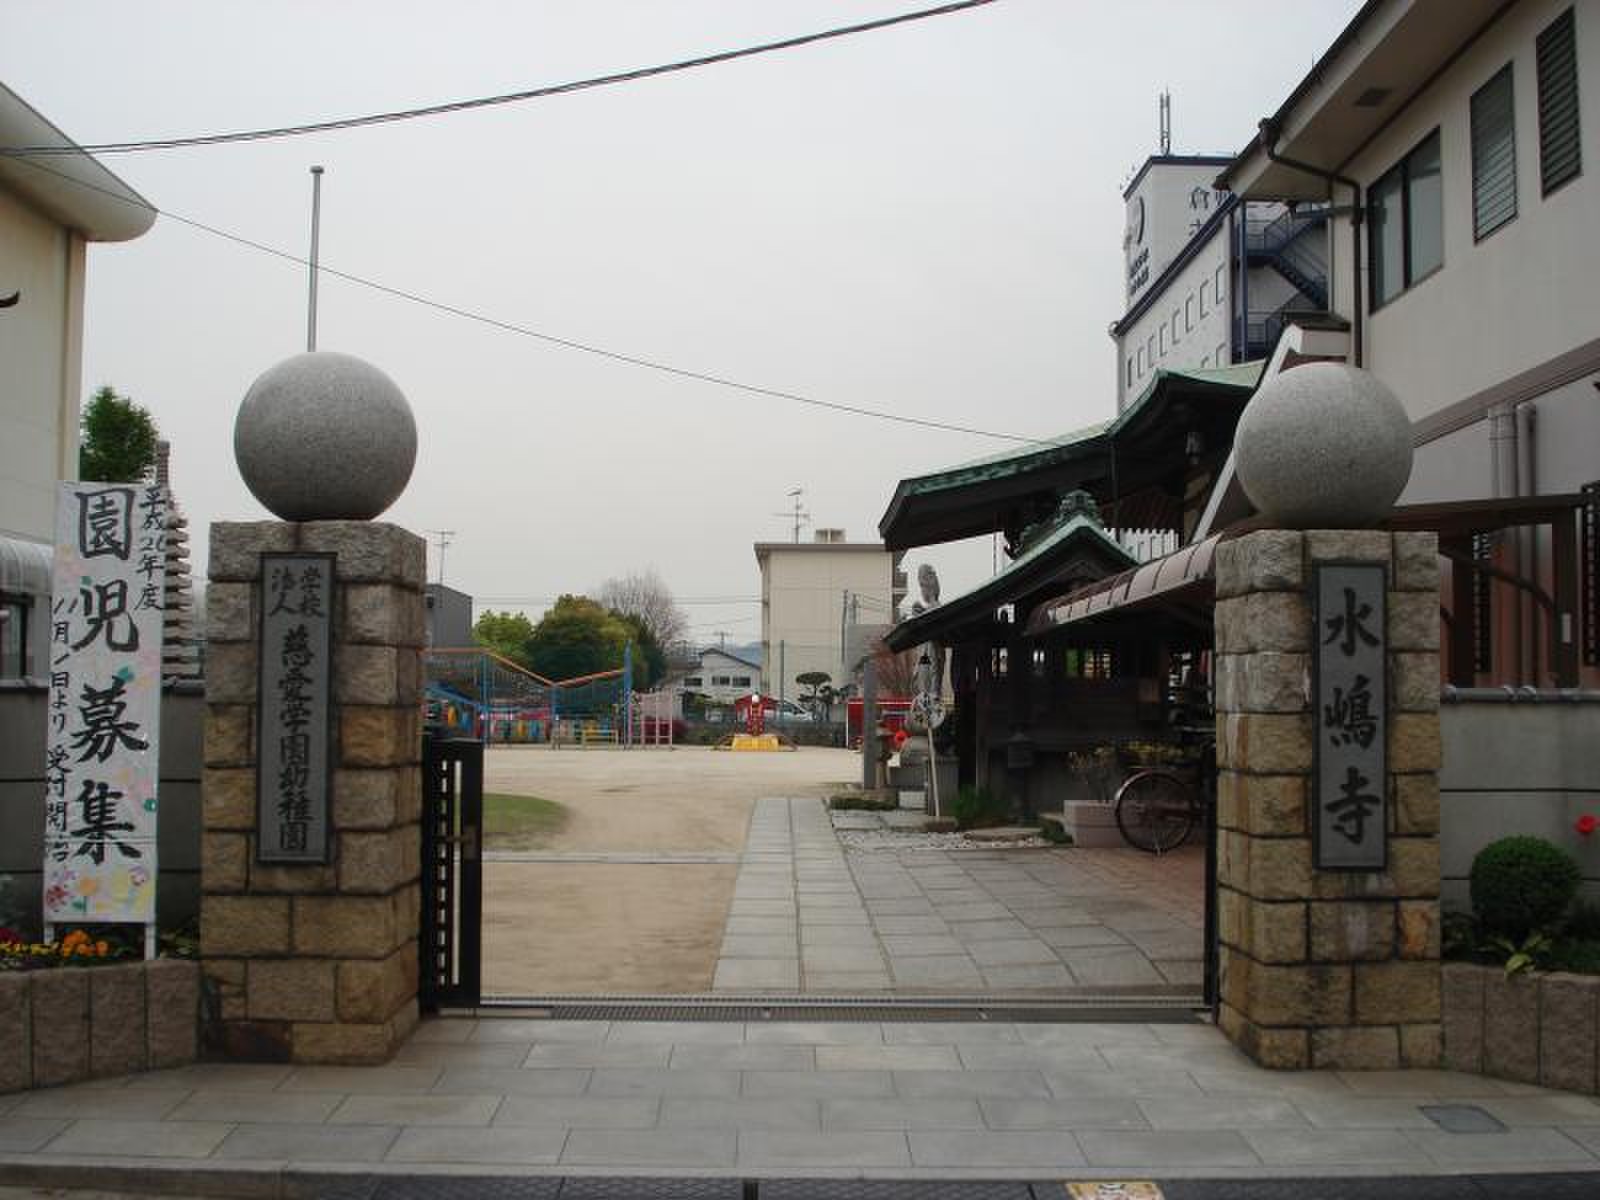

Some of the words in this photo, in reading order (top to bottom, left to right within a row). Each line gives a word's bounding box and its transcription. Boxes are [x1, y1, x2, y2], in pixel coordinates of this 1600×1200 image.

[70, 486, 150, 866] 園児募集
[1323, 587, 1381, 845] 水嶋寺
